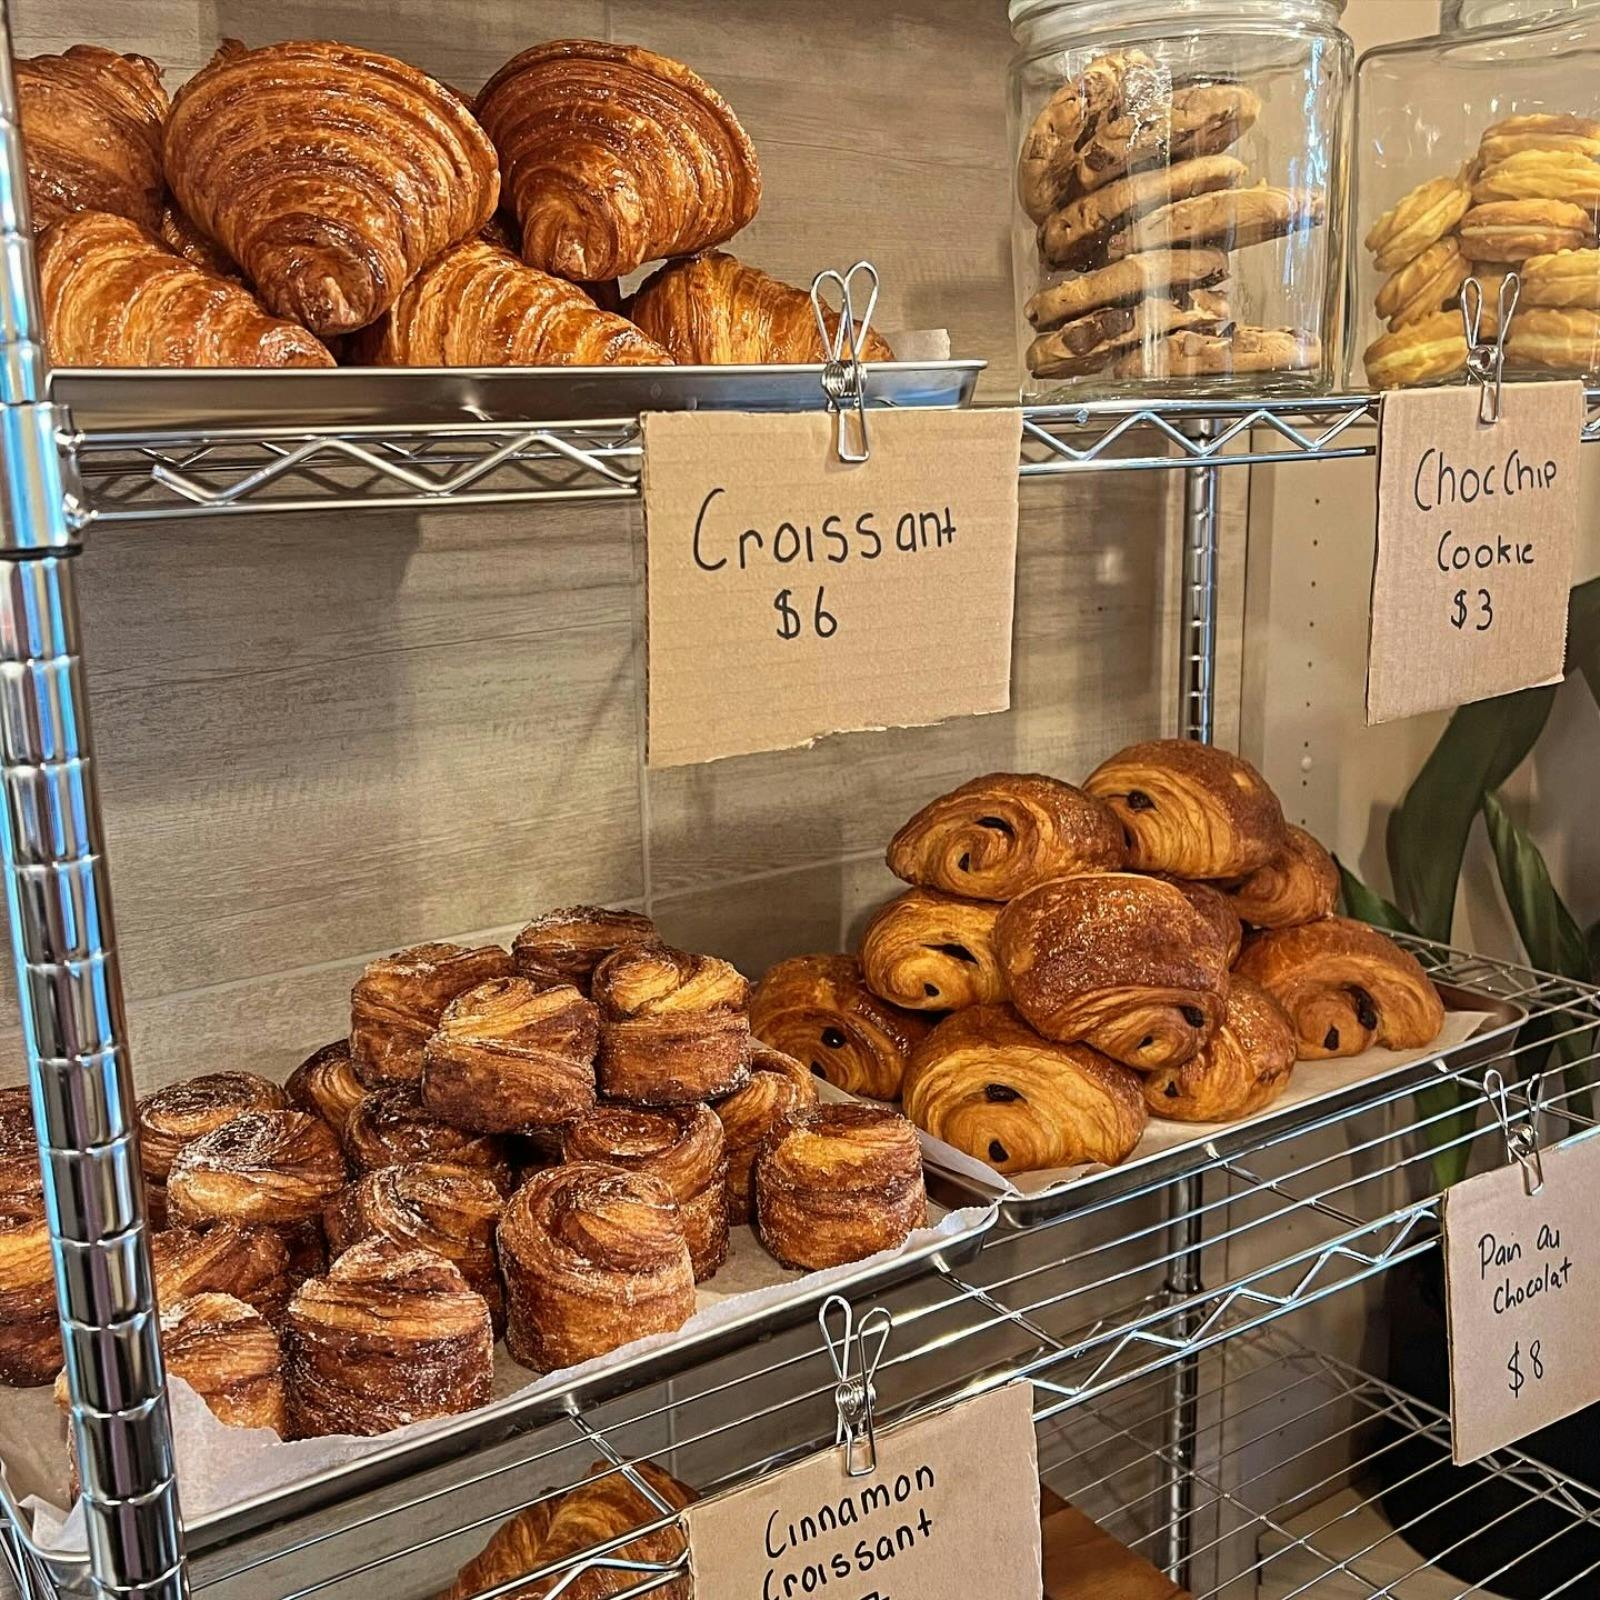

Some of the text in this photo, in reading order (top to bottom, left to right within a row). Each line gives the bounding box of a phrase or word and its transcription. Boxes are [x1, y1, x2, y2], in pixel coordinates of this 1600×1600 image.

[693, 488, 957, 571] Croissant
[1437, 530, 1534, 572] Cookie
[773, 585, 838, 641] $6
[1450, 588, 1493, 631] $3
[1477, 1223, 1560, 1281] Pain au
[1507, 1340, 1544, 1399] $8
[765, 1464, 935, 1559] Cinnamon
[762, 1508, 933, 1600] Croissant
